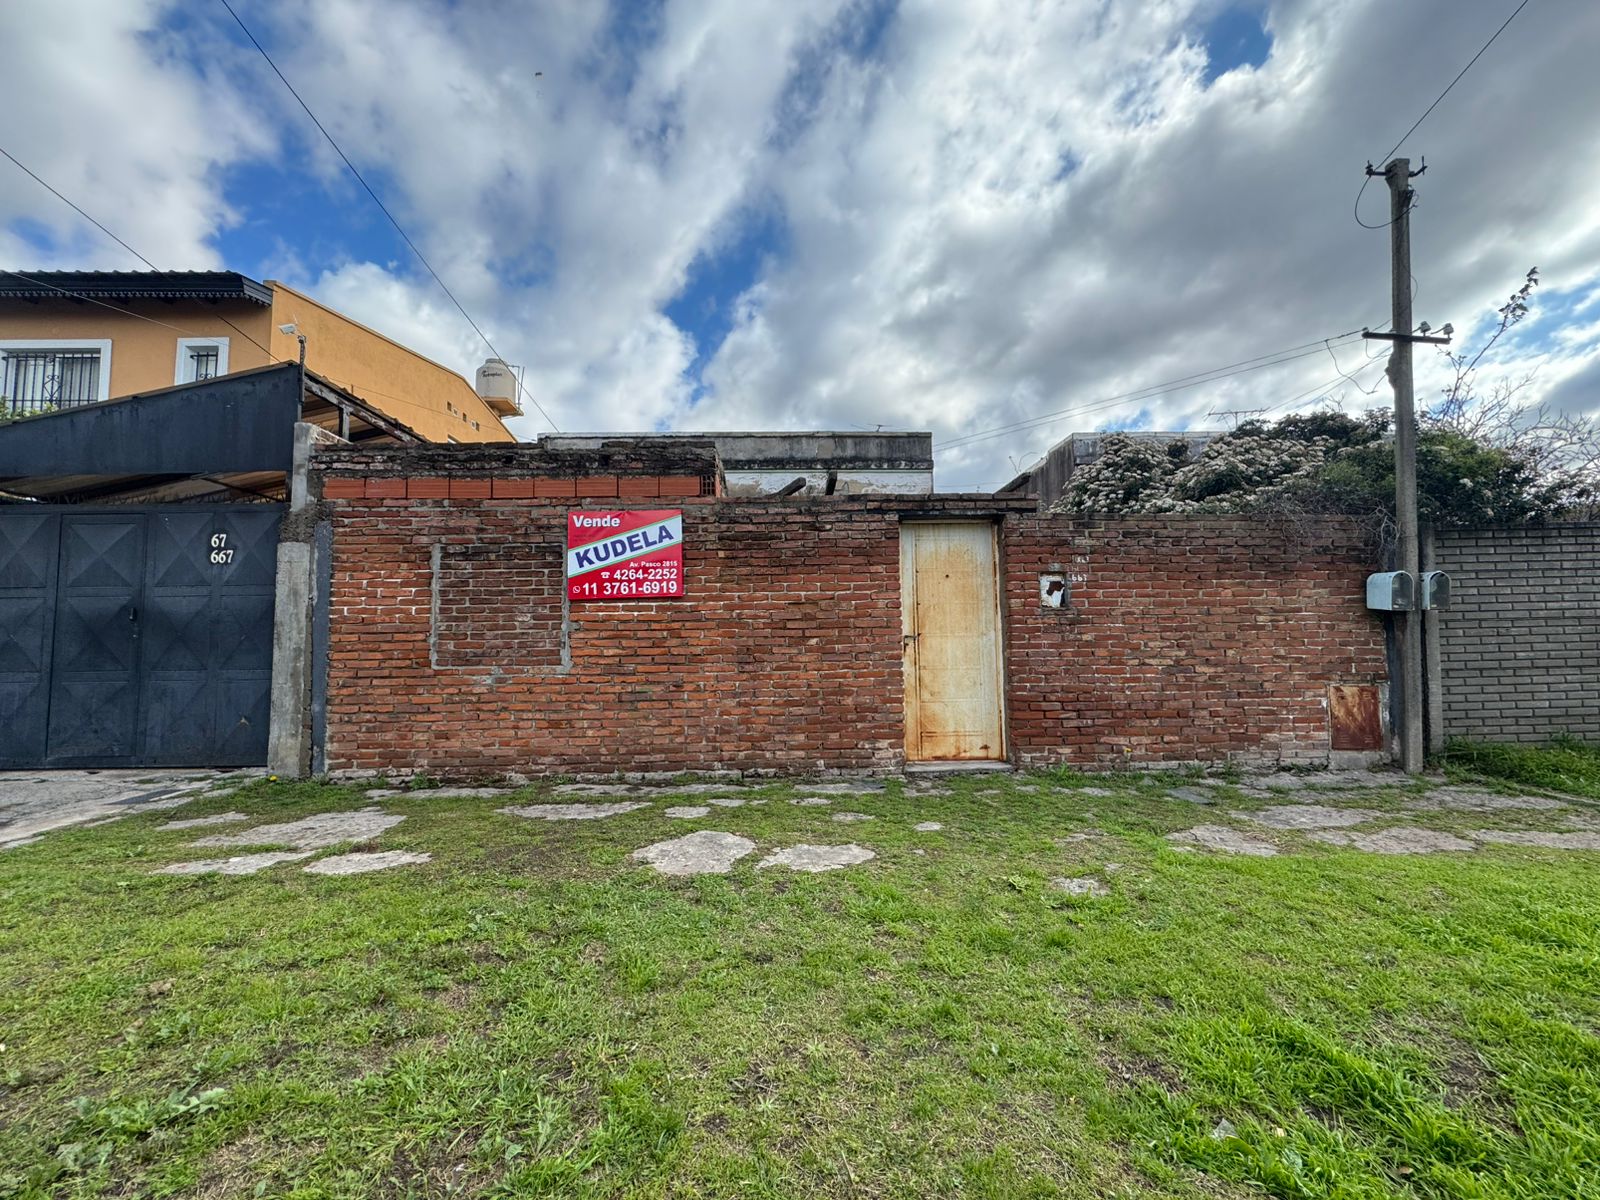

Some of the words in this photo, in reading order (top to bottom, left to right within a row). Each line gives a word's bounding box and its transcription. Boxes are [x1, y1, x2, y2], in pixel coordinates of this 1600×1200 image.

[572, 515, 621, 528] Vende
[210, 533, 227, 548] 67
[575, 525, 674, 569] KUDELA
[210, 549, 234, 564] 667
[613, 568, 677, 580] 4264-2252
[582, 583, 598, 595] 11
[603, 581, 677, 595] 3761-6919
